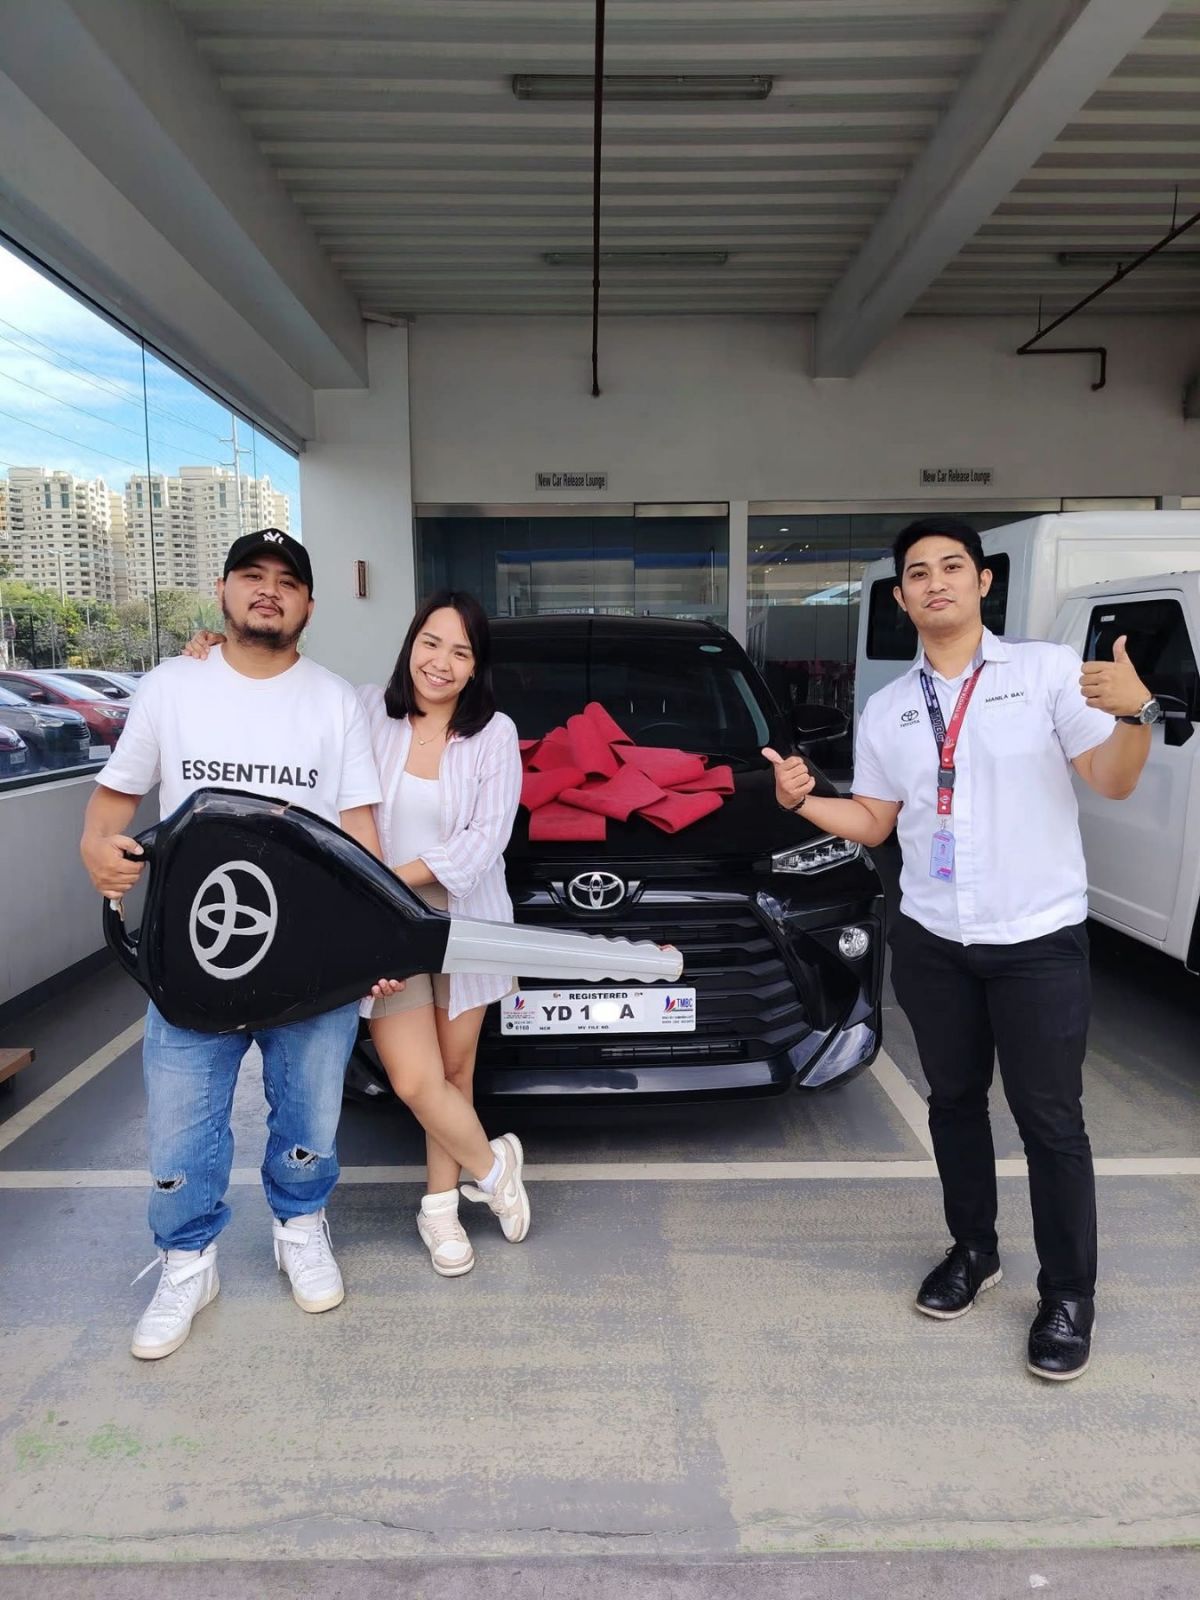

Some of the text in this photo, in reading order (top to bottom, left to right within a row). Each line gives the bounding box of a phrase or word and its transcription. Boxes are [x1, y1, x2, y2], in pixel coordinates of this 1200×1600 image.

[538, 473, 605, 489] New Car Release Lounge
[922, 468, 991, 485] New Car Release Lounge
[985, 691, 1025, 704] MANILA BAY
[900, 720, 920, 728] TOYOTA
[181, 759, 319, 789] ESSENTIALS
[568, 992, 628, 1000] REGISTERED
[542, 1005, 572, 1021] YD
